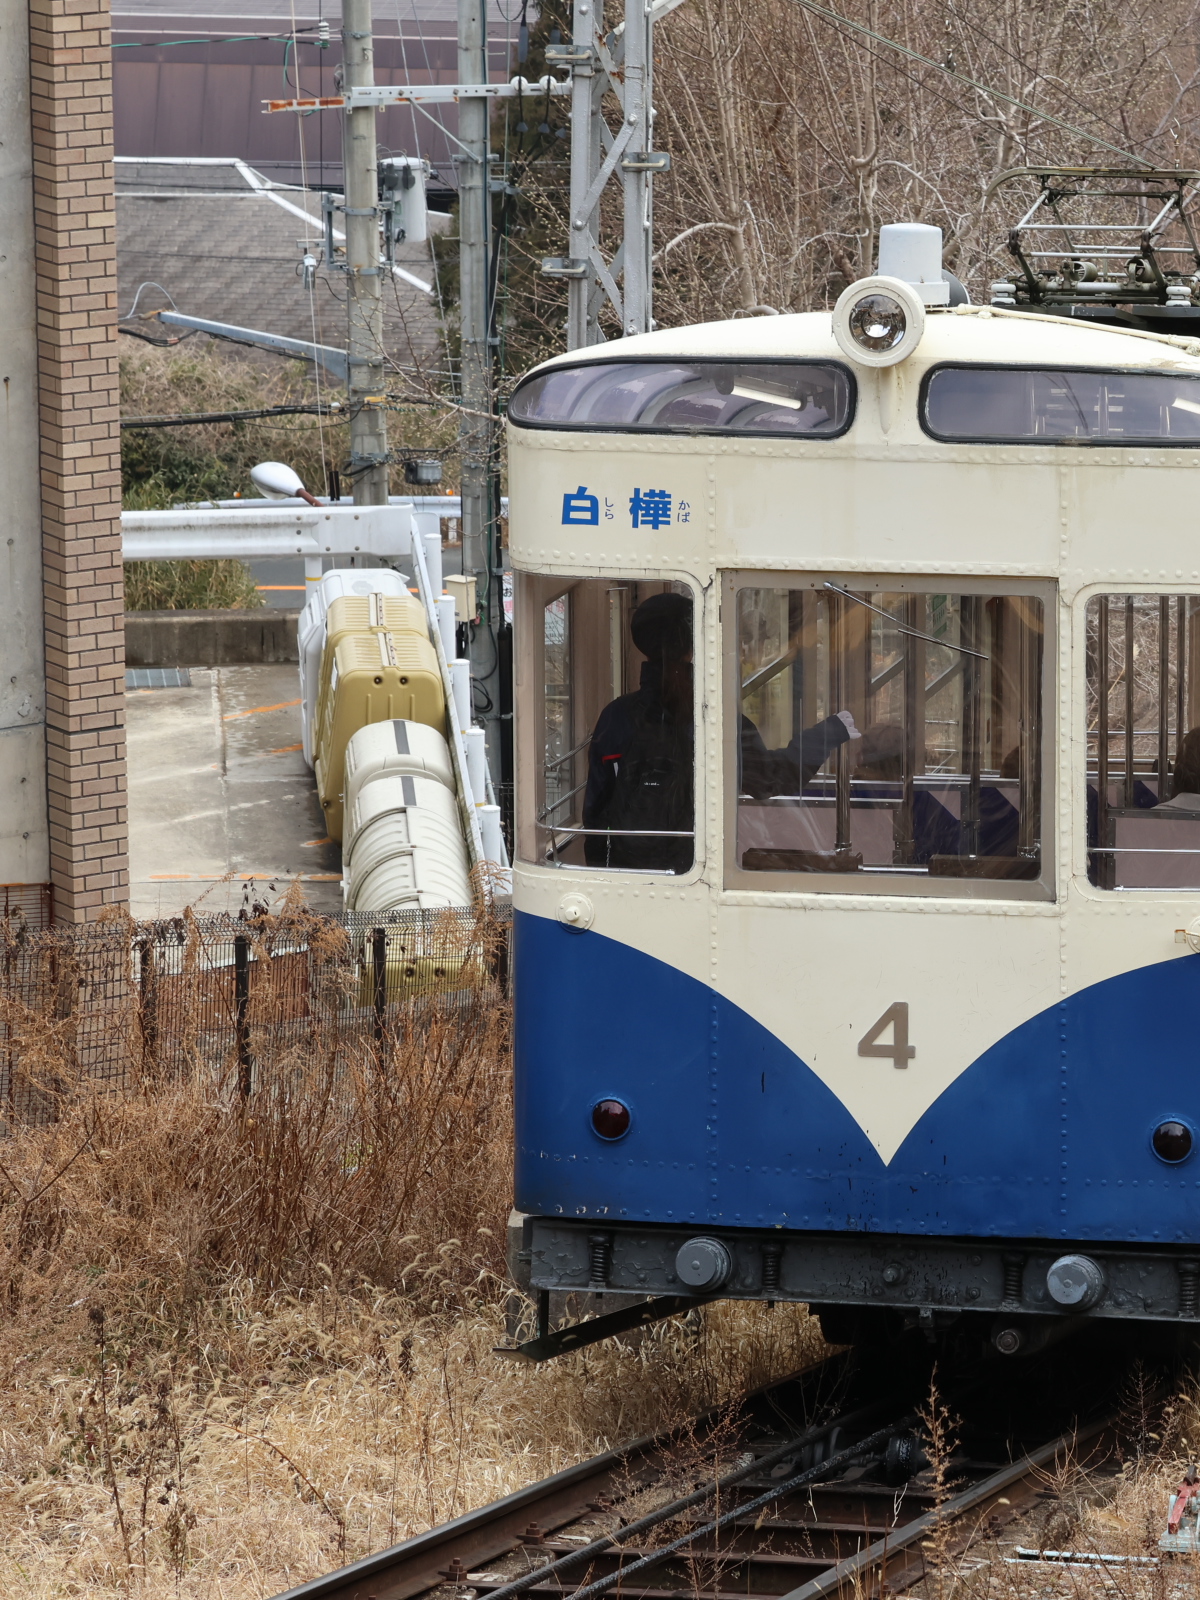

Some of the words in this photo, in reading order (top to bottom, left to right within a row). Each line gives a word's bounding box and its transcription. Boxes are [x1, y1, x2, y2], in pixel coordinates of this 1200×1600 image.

[562, 486, 599, 526] 白
[629, 488, 672, 530] 樺
[604, 497, 614, 520] しら
[677, 500, 691, 523] かば
[858, 1001, 916, 1070] 4
